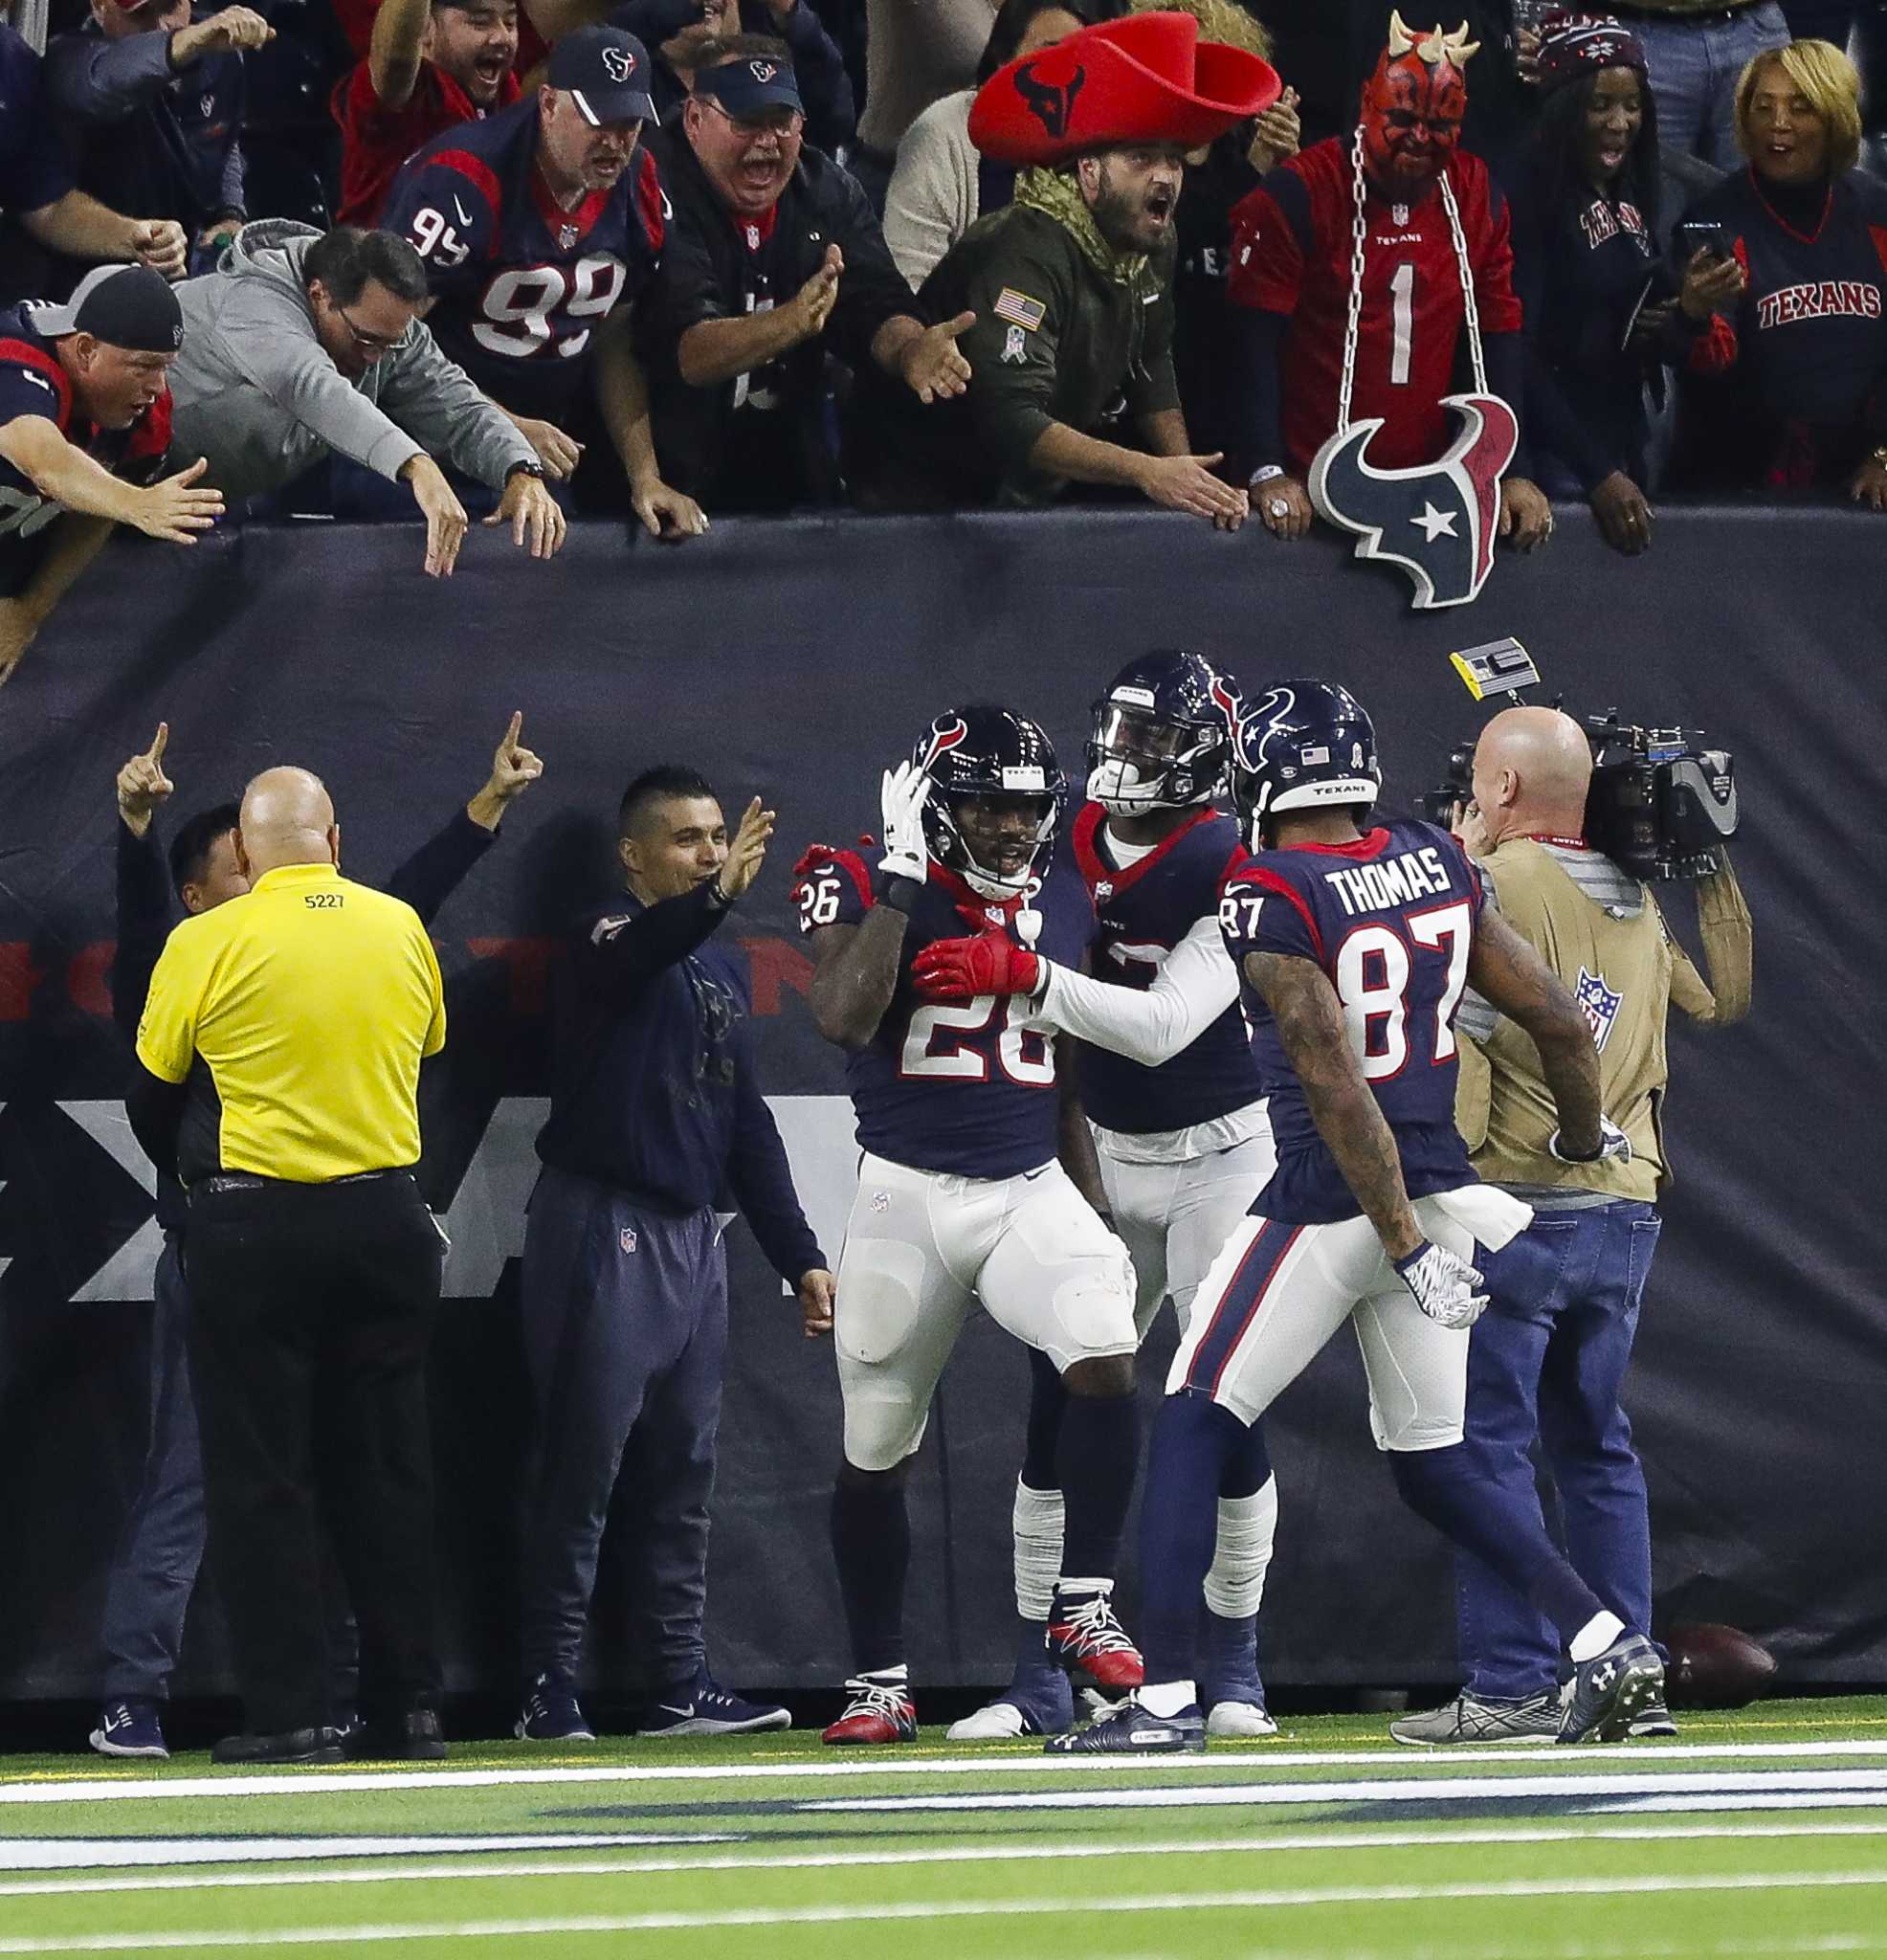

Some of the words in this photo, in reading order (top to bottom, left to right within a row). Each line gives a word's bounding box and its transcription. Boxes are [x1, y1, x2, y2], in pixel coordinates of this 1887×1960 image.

[1389, 263, 1413, 385] 1
[1757, 280, 1882, 330] TEXANS
[1312, 785, 1366, 795] TEXANS
[304, 894, 344, 909] 5227
[1324, 847, 1452, 916] THOMAS
[1218, 896, 1265, 940] 87
[1335, 900, 1476, 1082] 87
